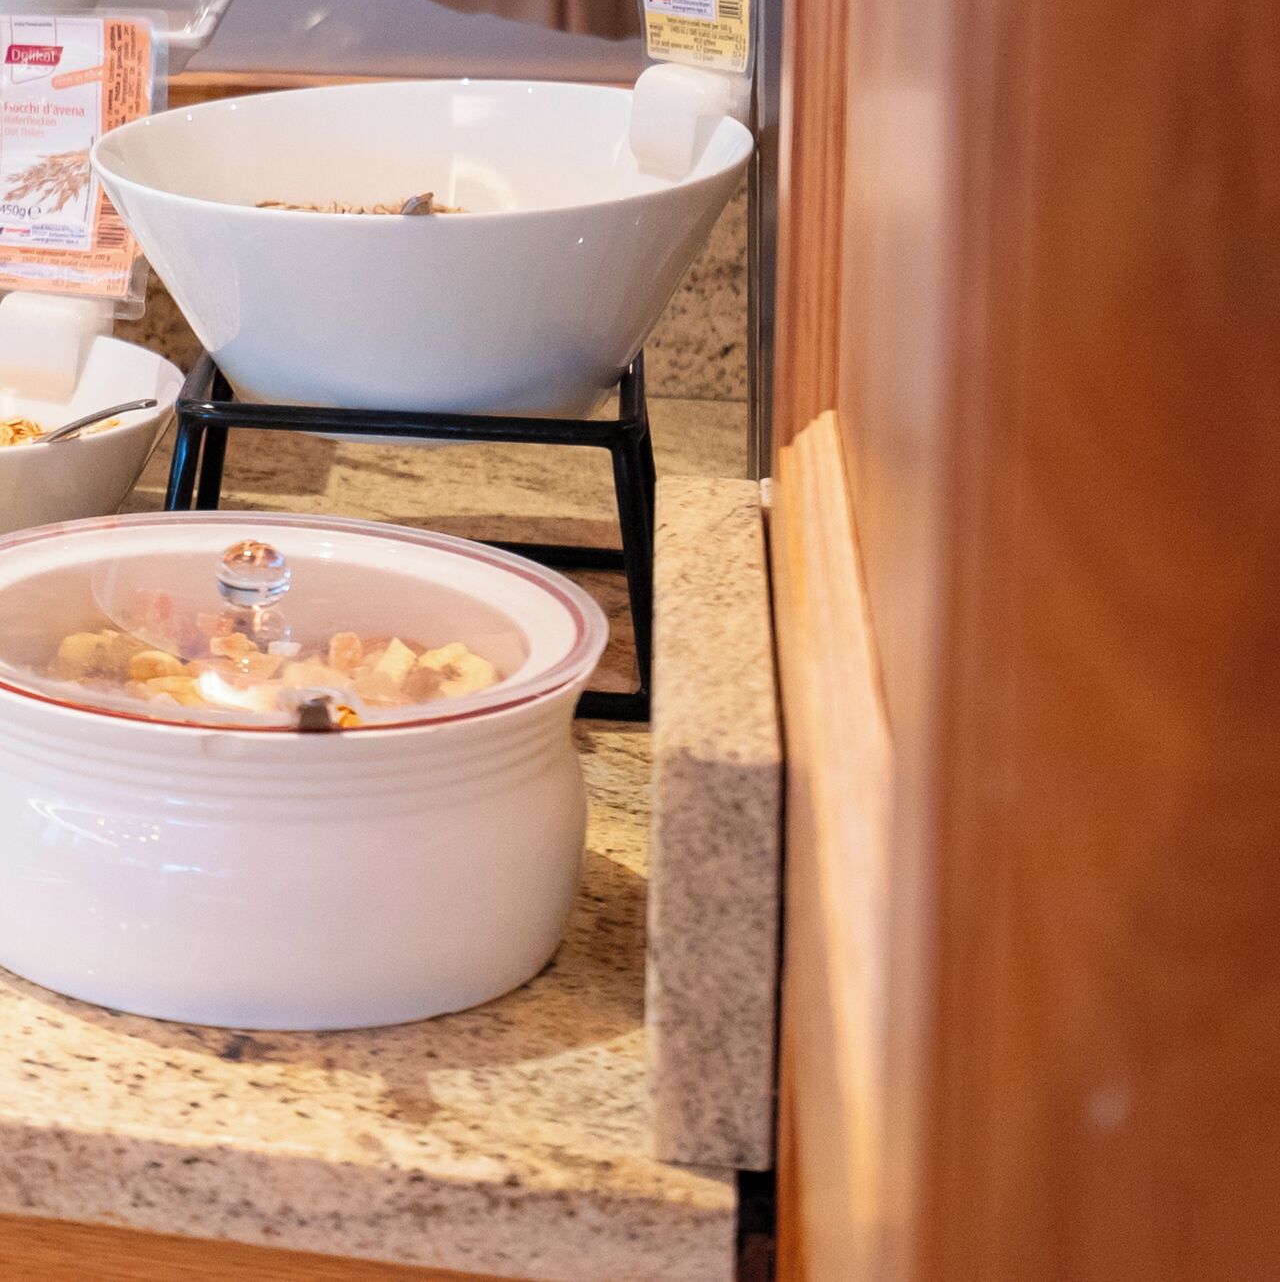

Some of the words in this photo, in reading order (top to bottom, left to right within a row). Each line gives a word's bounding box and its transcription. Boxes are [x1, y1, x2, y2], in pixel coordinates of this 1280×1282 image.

[11, 50, 55, 62] Delikat
[4, 102, 39, 114] Fiocchi
[43, 104, 85, 117] d'avena
[0, 204, 26, 217] 450g
